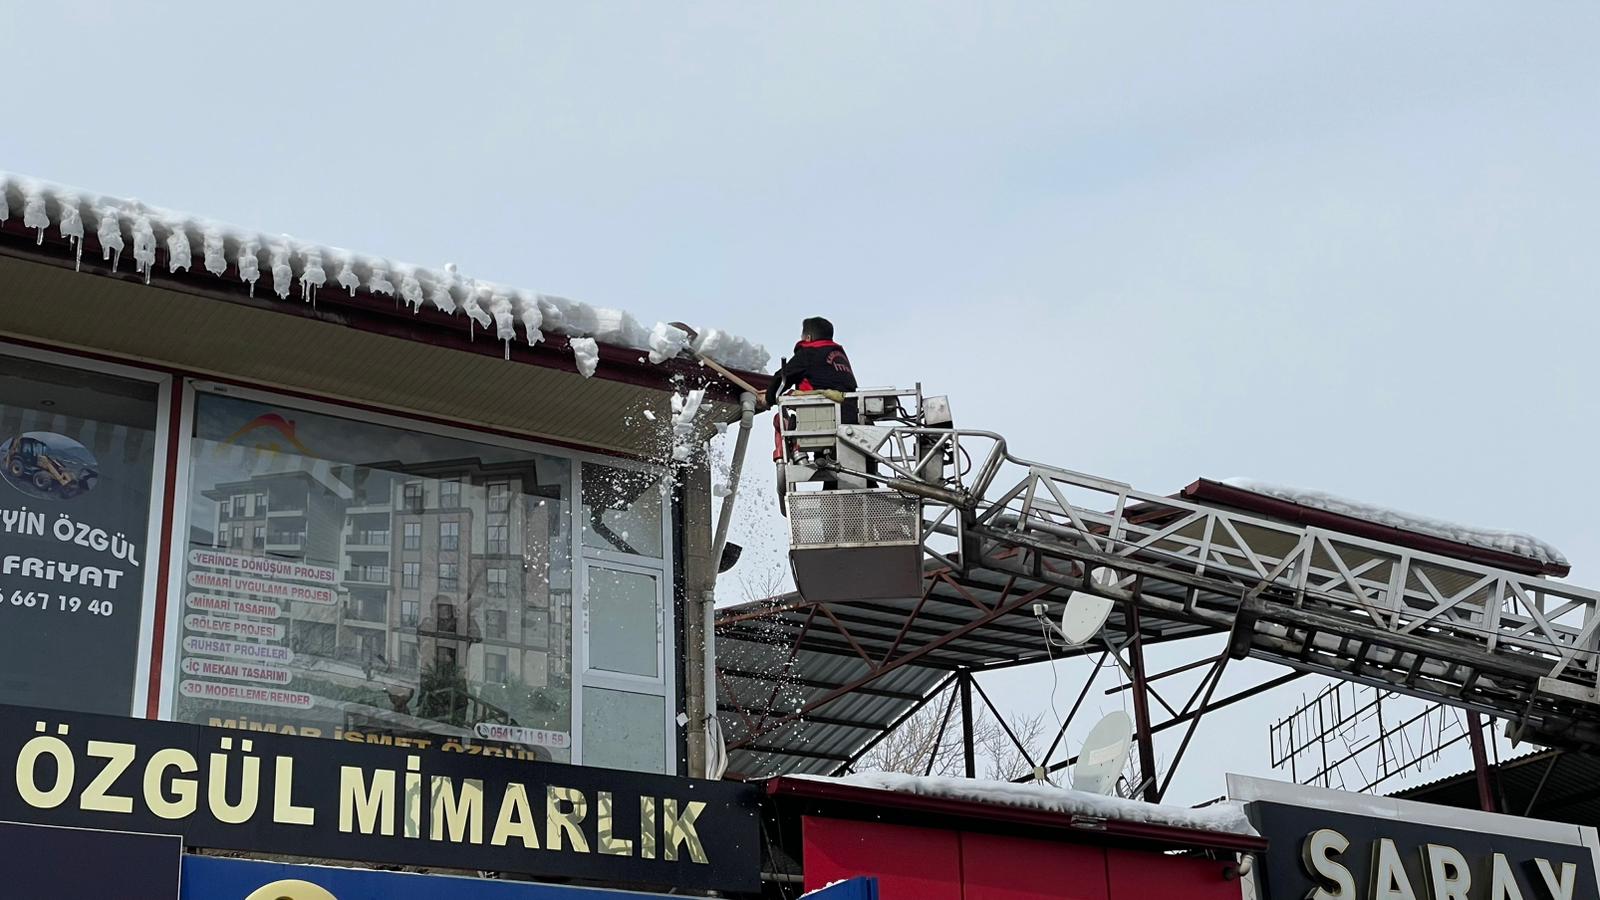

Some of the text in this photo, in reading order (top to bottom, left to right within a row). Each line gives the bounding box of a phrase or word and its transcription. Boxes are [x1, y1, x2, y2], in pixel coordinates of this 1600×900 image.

[0, 506, 139, 567] YİN ÖZGÜL
[294, 567, 335, 581] PROJESİ
[235, 579, 288, 595] UYGULAMA
[10, 590, 49, 610] 667
[58, 595, 82, 612] 19
[87, 599, 113, 616] 40
[233, 602, 276, 617] TASARIM
[234, 623, 276, 637] PROJESİ
[234, 644, 288, 660] PROJELERİ
[203, 662, 238, 676] MEKAN
[241, 667, 287, 682] TASARIMI
[205, 684, 310, 705] MODELLEME/RENDER
[490, 726, 513, 739] 0541
[517, 729, 533, 743] 711
[537, 732, 548, 744] 91
[15, 721, 709, 864] ÖZGÜL MİMARLIK
[1303, 829, 1577, 900] SARAY
